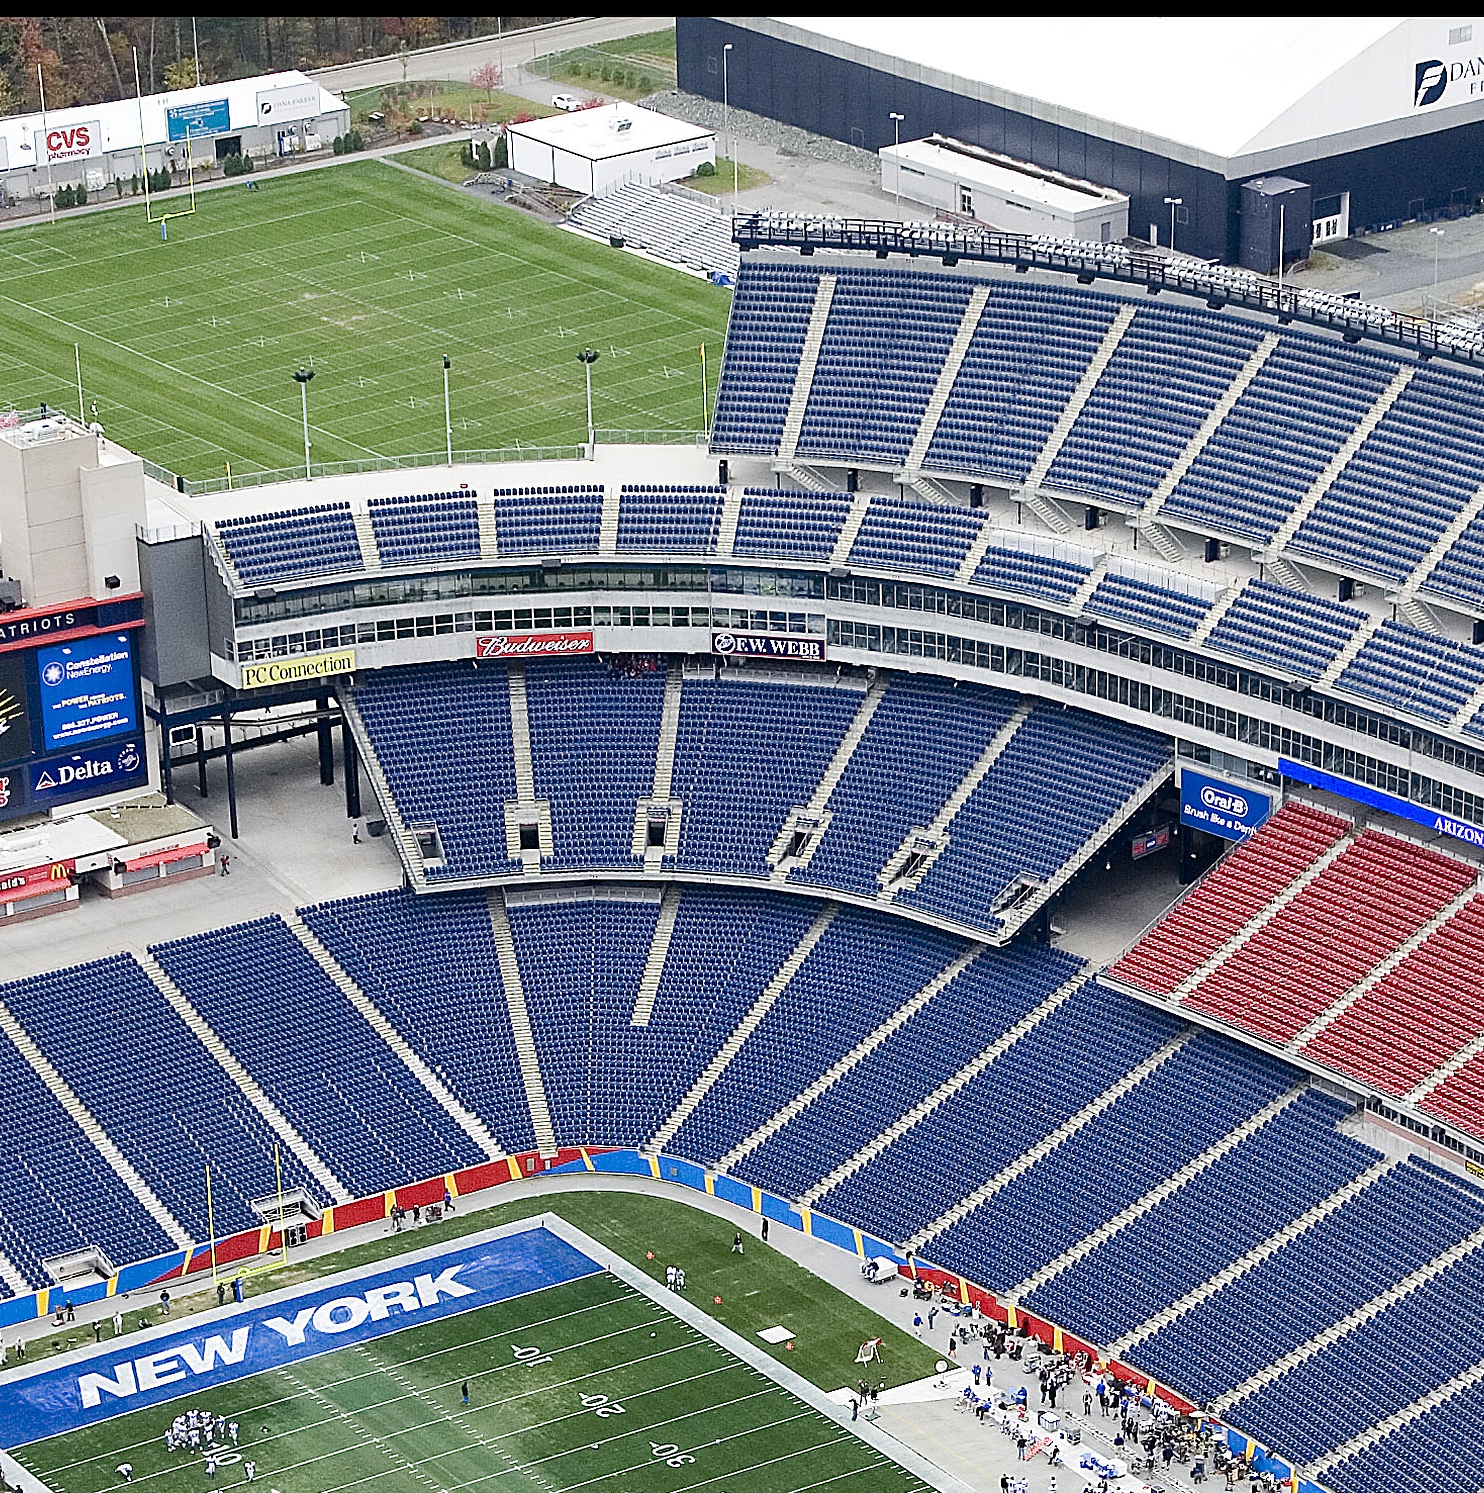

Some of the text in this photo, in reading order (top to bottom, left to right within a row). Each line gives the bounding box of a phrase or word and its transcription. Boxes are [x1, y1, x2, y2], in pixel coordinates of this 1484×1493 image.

[47, 127, 90, 151] CVS
[49, 148, 90, 162] pharmacy
[479, 637, 591, 656] Budweiser
[736, 637, 767, 653] F.W.
[769, 639, 820, 656] WEBB
[66, 651, 128, 671] Constellation
[246, 657, 351, 685] PC Connection
[61, 695, 89, 707] POWER
[58, 760, 113, 784] Delta
[1204, 790, 1247, 814] Oral-B
[1184, 804, 1210, 820] Brush
[1210, 812, 1225, 826] like
[1226, 821, 1232, 829] a
[78, 1264, 478, 1408] NEW YORK
[582, 1394, 626, 1418] 20
[653, 1444, 695, 1468] 30
